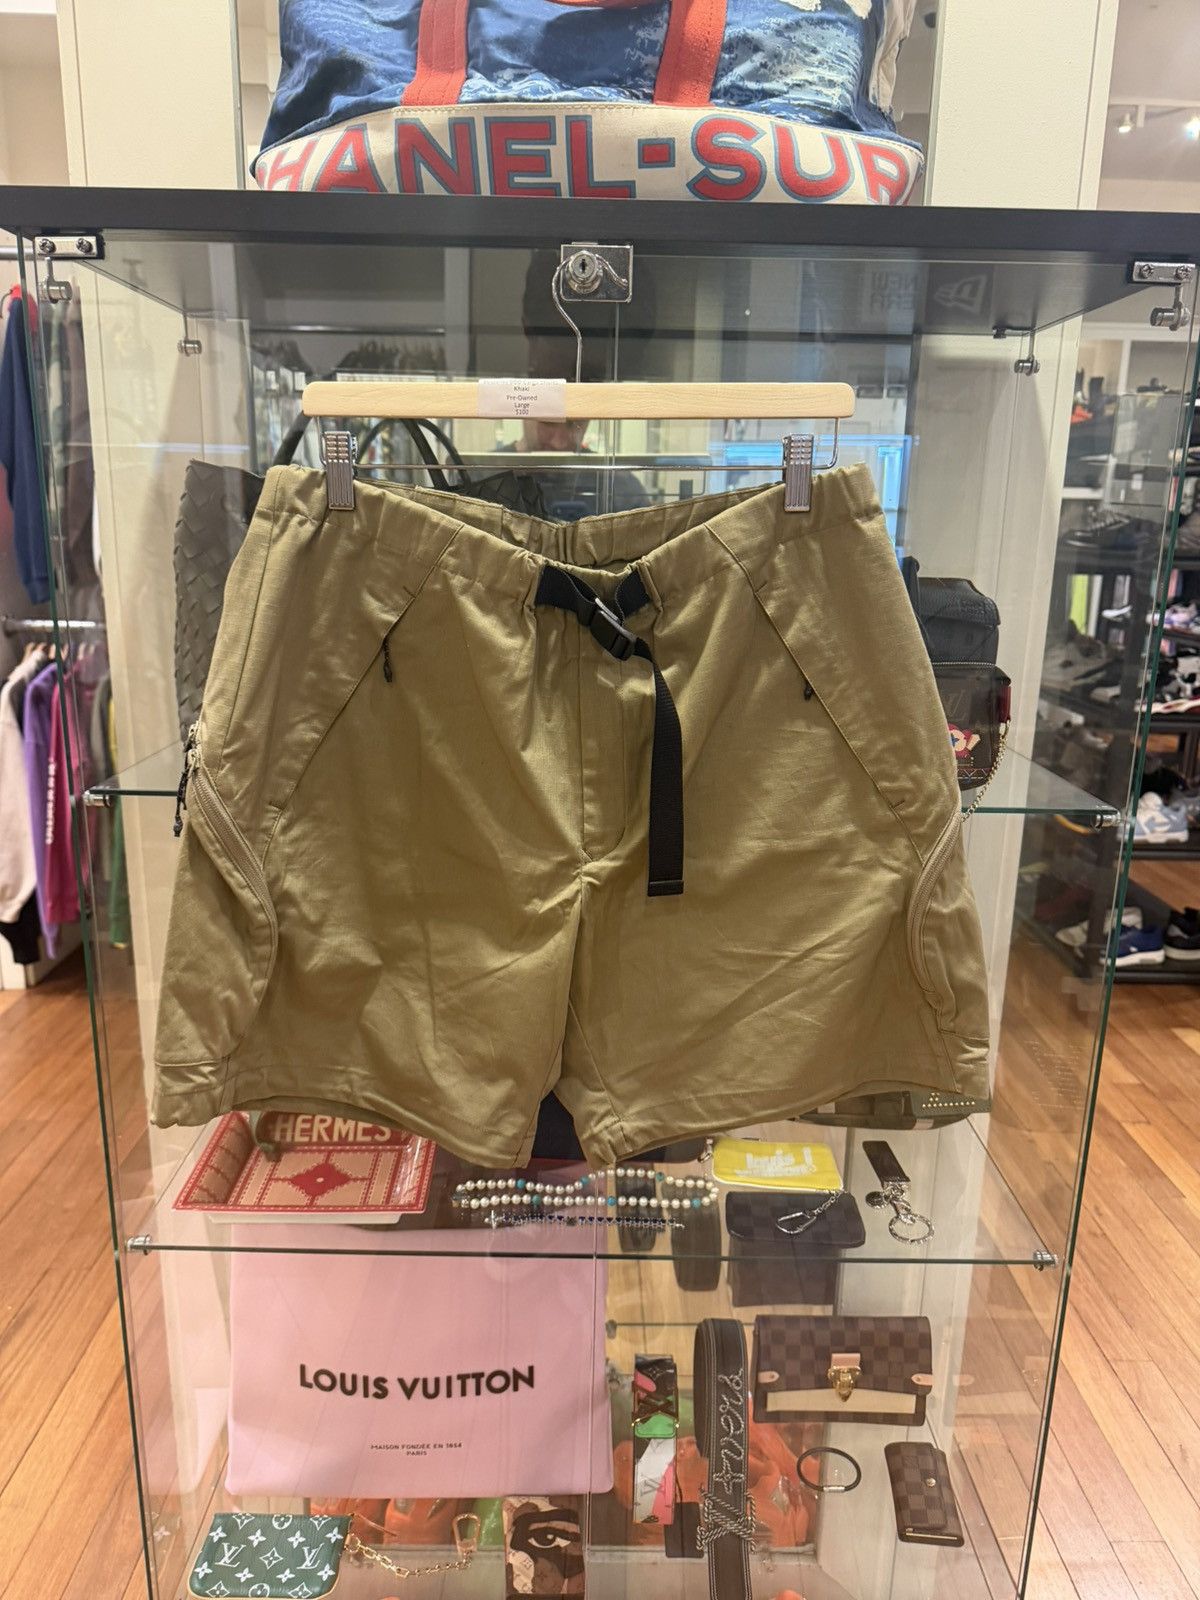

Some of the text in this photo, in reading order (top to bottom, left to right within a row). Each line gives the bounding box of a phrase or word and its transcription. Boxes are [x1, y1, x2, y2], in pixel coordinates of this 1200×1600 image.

[299, 1363, 535, 1400] LOUIS VUITTON
[370, 1443, 400, 1451] MAISON
